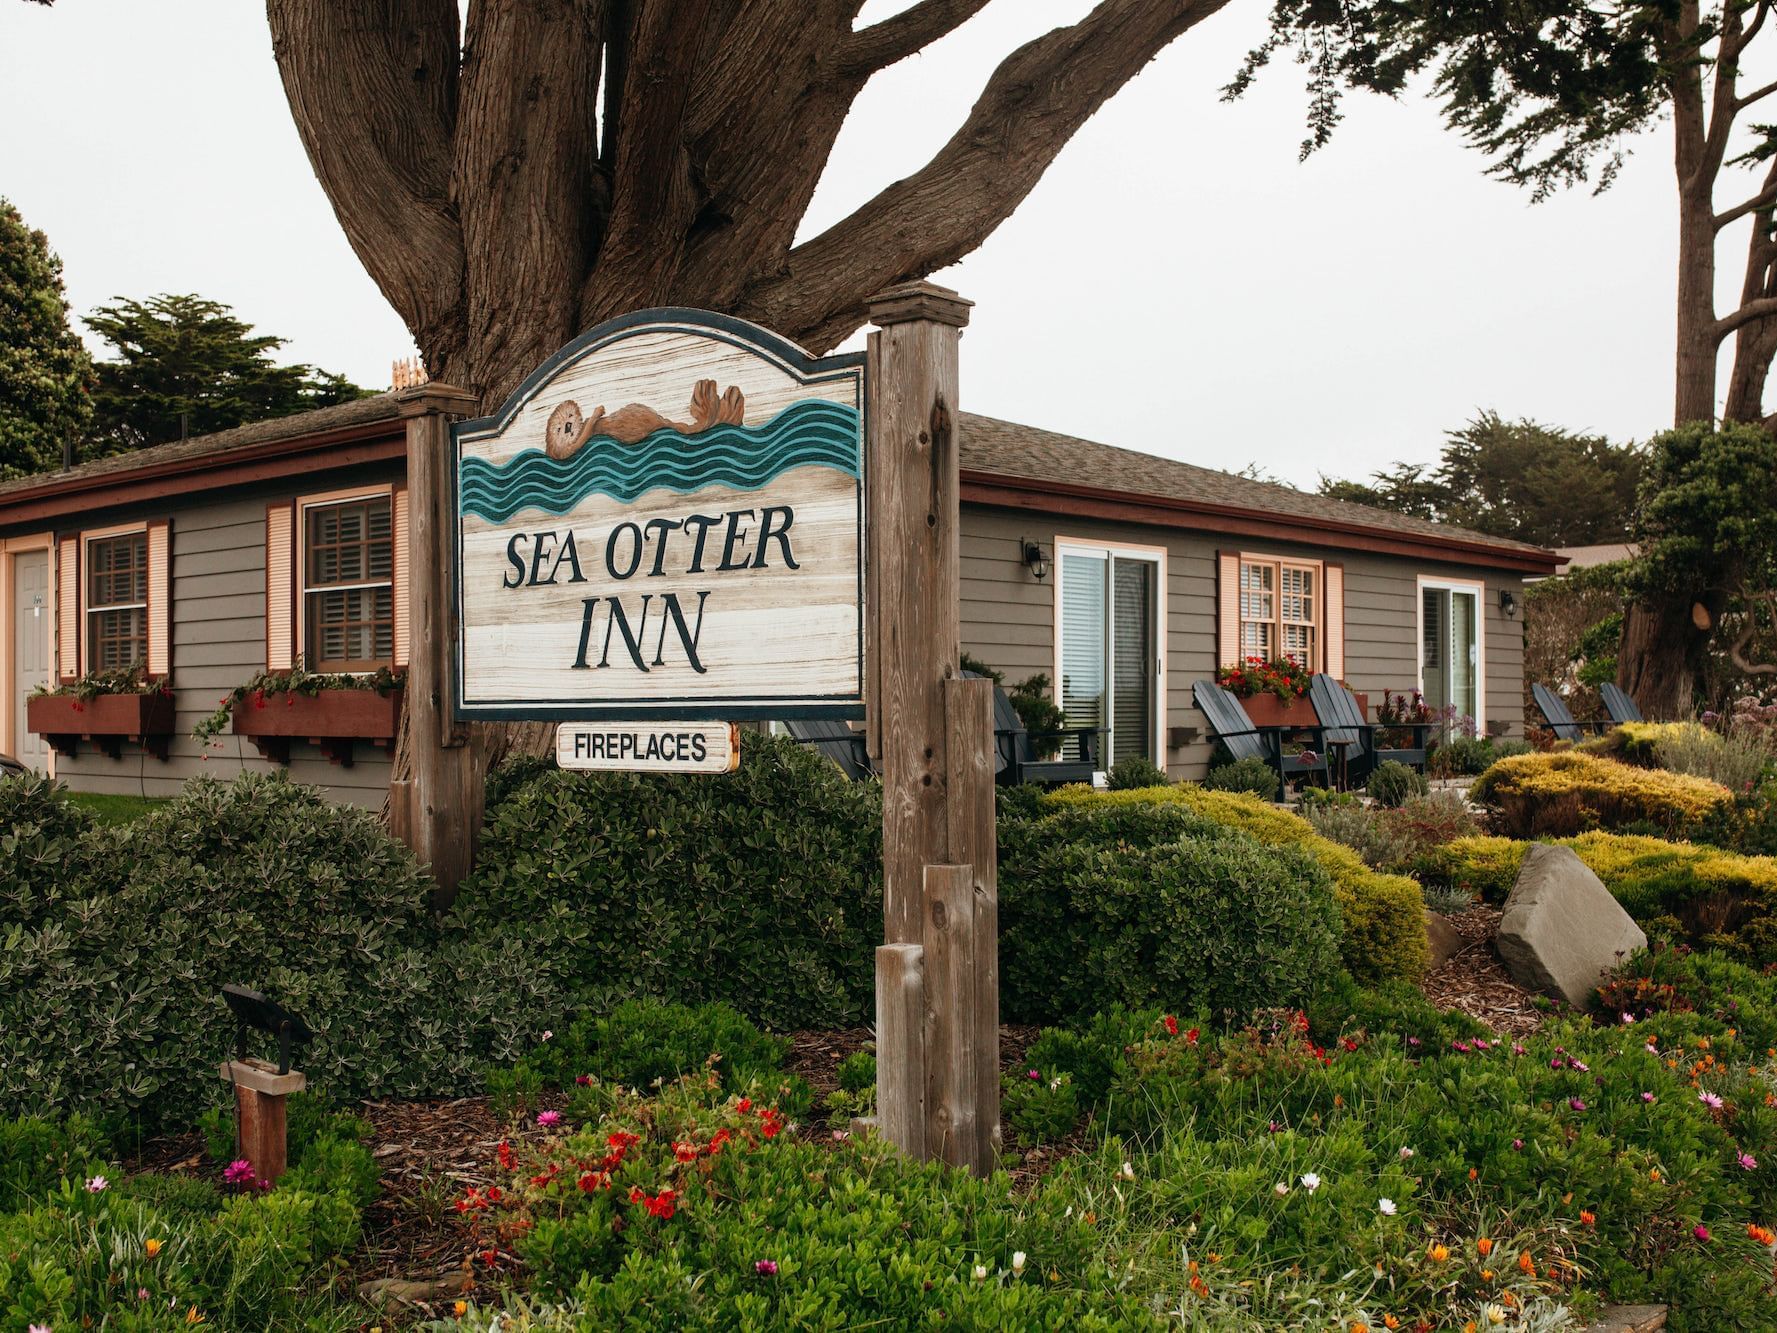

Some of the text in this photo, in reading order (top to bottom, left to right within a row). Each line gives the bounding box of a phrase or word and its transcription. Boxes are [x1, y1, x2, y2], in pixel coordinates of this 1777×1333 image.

[503, 505, 800, 589] SEA OTTER
[572, 591, 711, 674] INN
[574, 733, 706, 762] FIREPLACES
